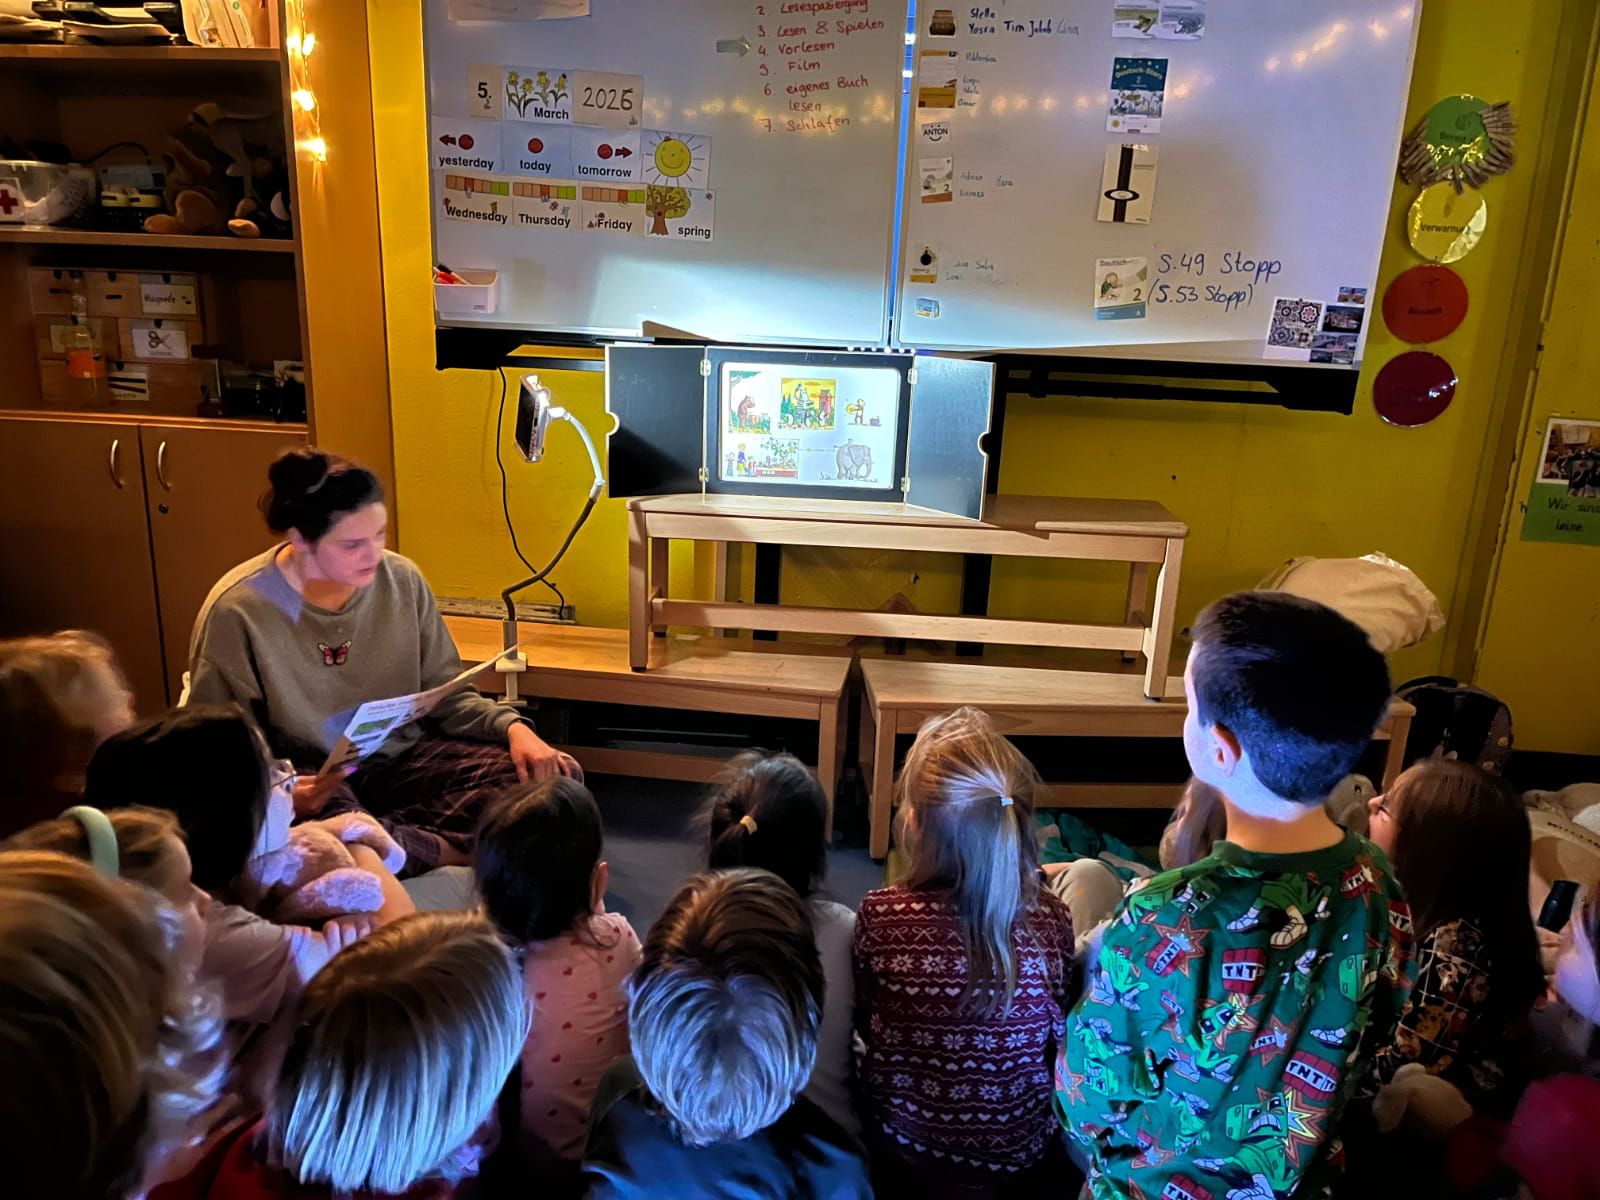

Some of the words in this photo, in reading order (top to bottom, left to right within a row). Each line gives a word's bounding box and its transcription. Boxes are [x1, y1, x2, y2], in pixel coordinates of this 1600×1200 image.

[756, 6, 771, 16] 2.
[757, 25, 770, 38] 3.
[777, 26, 807, 37] Lesen
[815, 21, 829, 34] &
[837, 19, 884, 36] Spielen
[1003, 20, 1025, 33] Tim
[758, 45, 769, 57] 4.
[778, 41, 835, 55] Vorlesen
[788, 60, 821, 71] Film
[763, 83, 776, 96] 6.
[786, 81, 830, 97] eigenes
[837, 75, 869, 89] Buch
[789, 99, 822, 112] lesen
[534, 107, 570, 121] March
[759, 118, 776, 133] 7.
[786, 115, 850, 133] Schlafen
[923, 127, 948, 137] ANTON
[438, 155, 494, 171] yesterday
[519, 159, 552, 173] today
[577, 164, 632, 178] tomorrow
[445, 205, 508, 223] Wednesday
[518, 213, 571, 228] Thursday
[597, 217, 633, 232] Friday
[678, 224, 711, 240] spring
[1100, 259, 1128, 267] Deutsch
[1220, 251, 1282, 285] Stopp
[1132, 288, 1142, 301] 2
[1548, 497, 1570, 510] Wir
[1159, 944, 1178, 964] TNT
[1224, 964, 1257, 979] TNT
[1289, 1062, 1324, 1085] TNT
